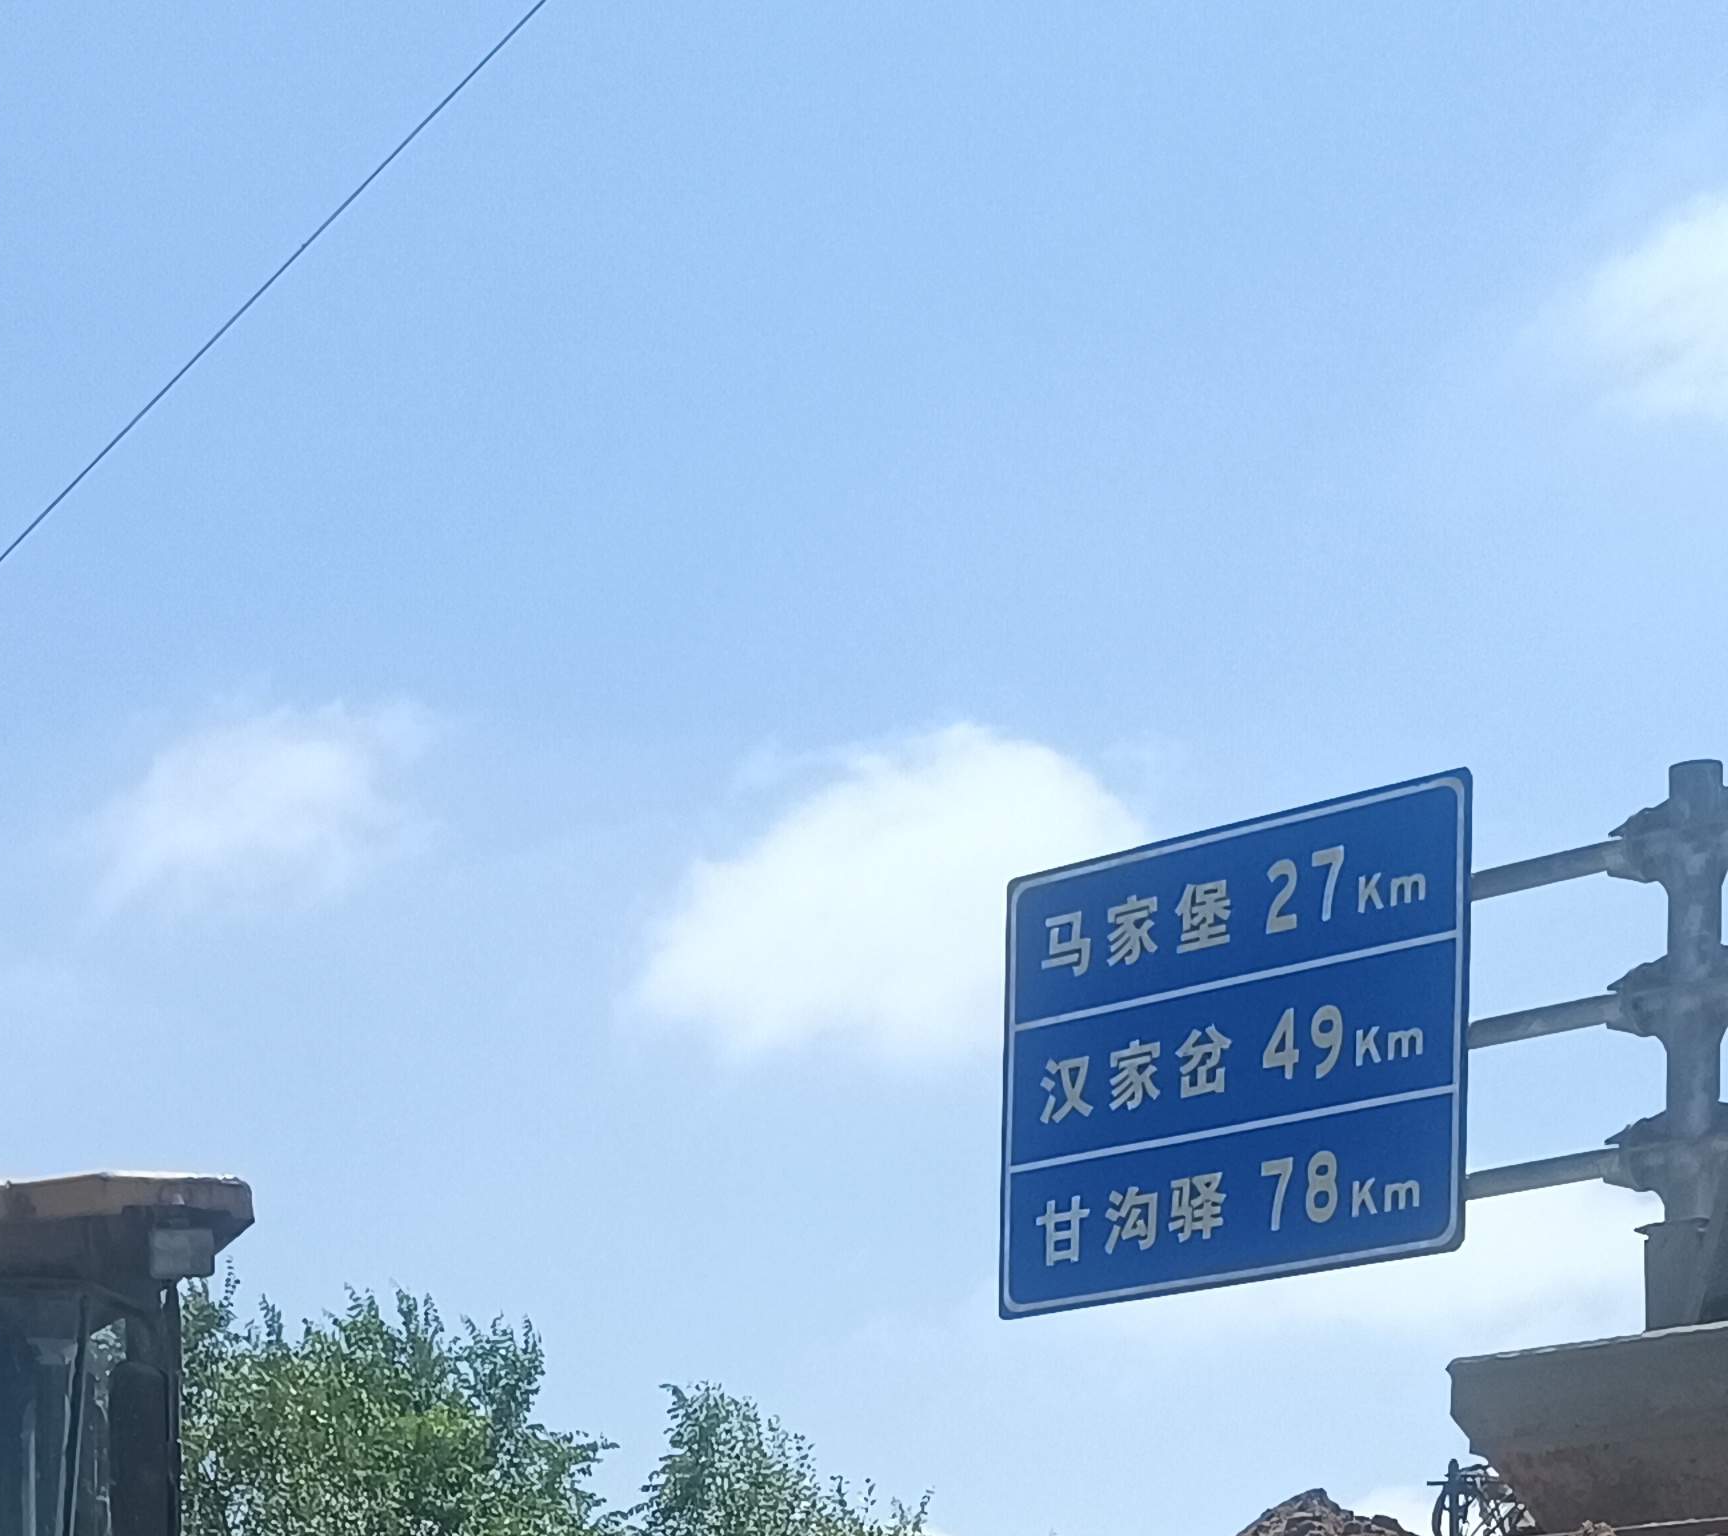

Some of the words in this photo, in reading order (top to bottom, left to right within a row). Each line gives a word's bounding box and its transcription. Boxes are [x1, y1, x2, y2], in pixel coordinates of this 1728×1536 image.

[1041, 879, 1232, 977] 马家堡
[1039, 1023, 1233, 1125] 汉家岔
[1035, 1171, 1227, 1267] 甘沟驿
